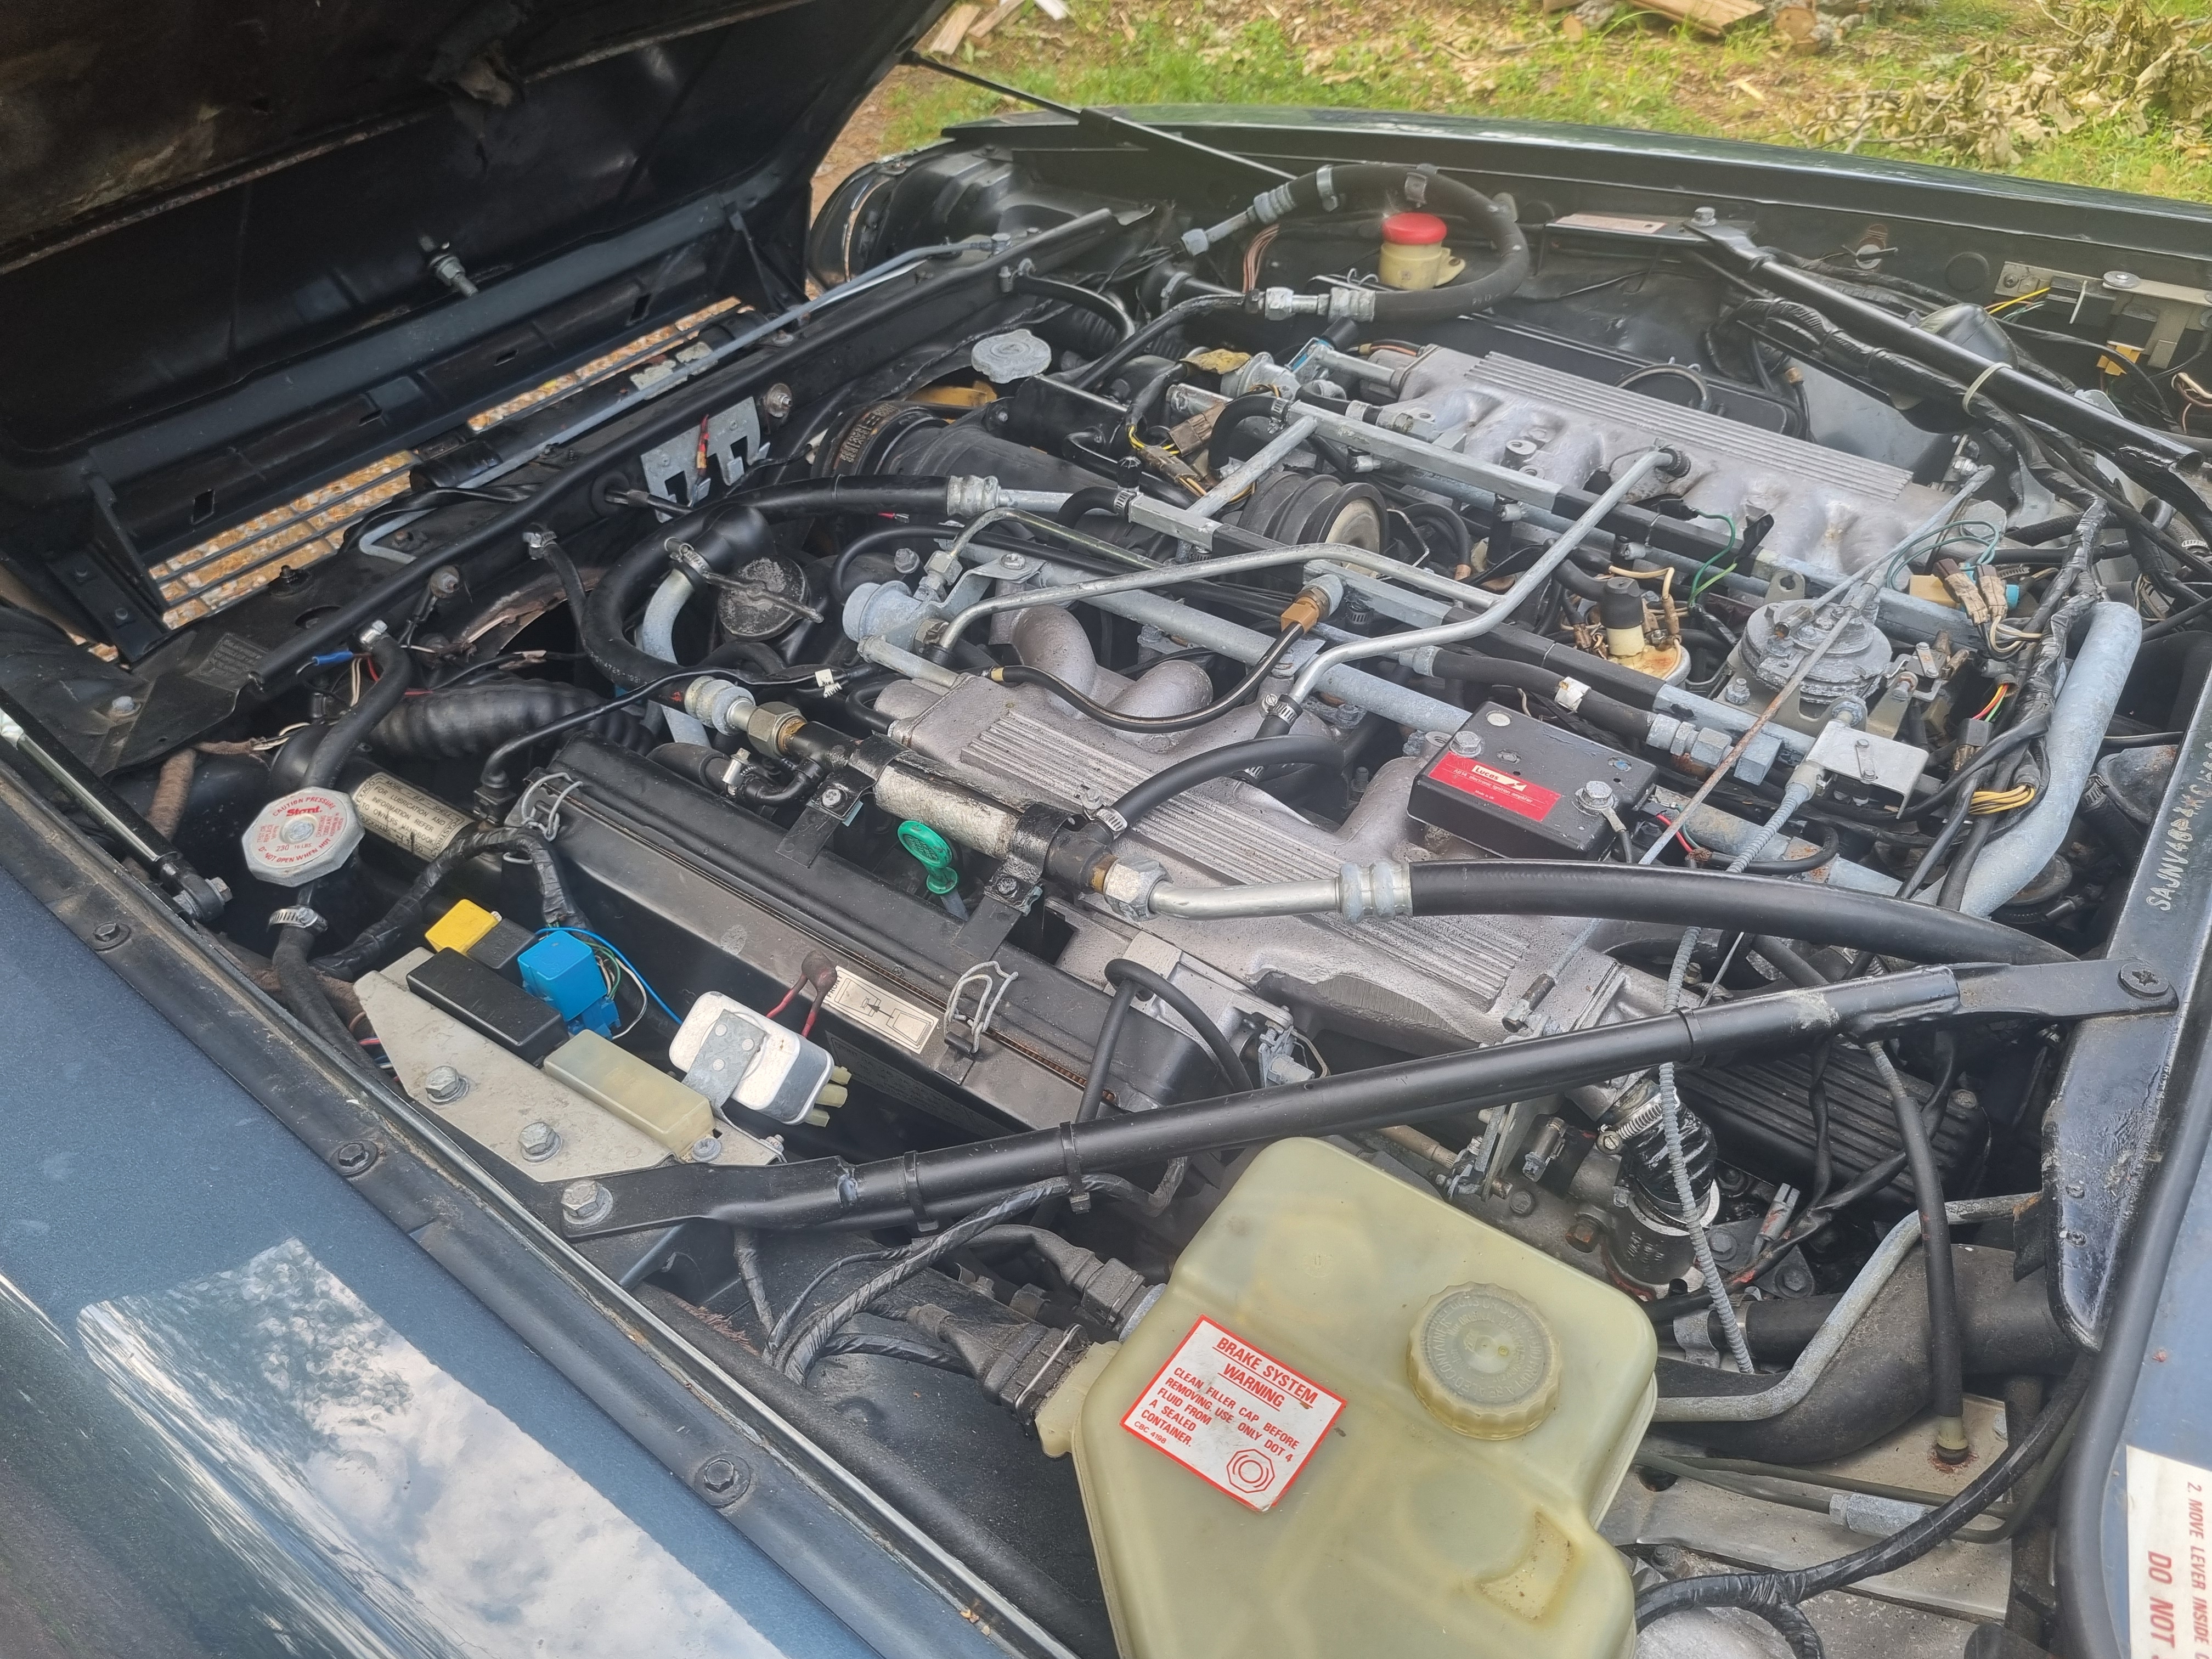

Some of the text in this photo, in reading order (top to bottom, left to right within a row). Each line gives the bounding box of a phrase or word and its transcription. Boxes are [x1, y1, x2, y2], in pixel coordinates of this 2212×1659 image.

[1469, 775, 1492, 787] electronic
[1492, 784, 1510, 794] ignition
[1511, 792, 1533, 803] amplifier
[1475, 767, 1499, 780] Lucas
[272, 797, 336, 817] CAUTION PRESSURE
[357, 781, 376, 805] EXACO
[374, 786, 446, 826] FOR LUBRICATION AND
[433, 805, 452, 817] SHELL
[362, 802, 436, 845] TO OWNERS HANDBOOK
[371, 797, 435, 832] INFORMATION REFER
[265, 852, 276, 862] NOT
[296, 848, 319, 860] WHEN
[319, 838, 331, 849] HOT
[406, 838, 424, 853] ESO
[435, 821, 457, 851] CASTROL
[826, 975, 842, 997] FRONT
[1432, 1318, 1457, 1380] CONTAINER
[1216, 1337, 1318, 1404] BRAKE SYSTEM
[1223, 1363, 1285, 1408] WARNING
[1149, 1399, 1197, 1432] A SEALED
[1157, 1387, 1212, 1425] FLUID FROM
[1173, 1367, 1300, 1449] CLEAN FILLER CAP BEFORE
[1134, 1421, 1167, 1444] CBC 4198
[1141, 1409, 1192, 1447] CONTAINER.
[1215, 1408, 1234, 1424] USE
[1238, 1423, 1263, 1441] ONLY
[1263, 1439, 1286, 1457] DOT
[1285, 1453, 1294, 1463] 4
[2188, 1498, 2204, 1539] MOVE
[2147, 1550, 2172, 1584] DO
[2190, 1545, 2206, 1590] LEVER
[2149, 1596, 2175, 1649] NOT
[2192, 1596, 2209, 1646] INSIDE
